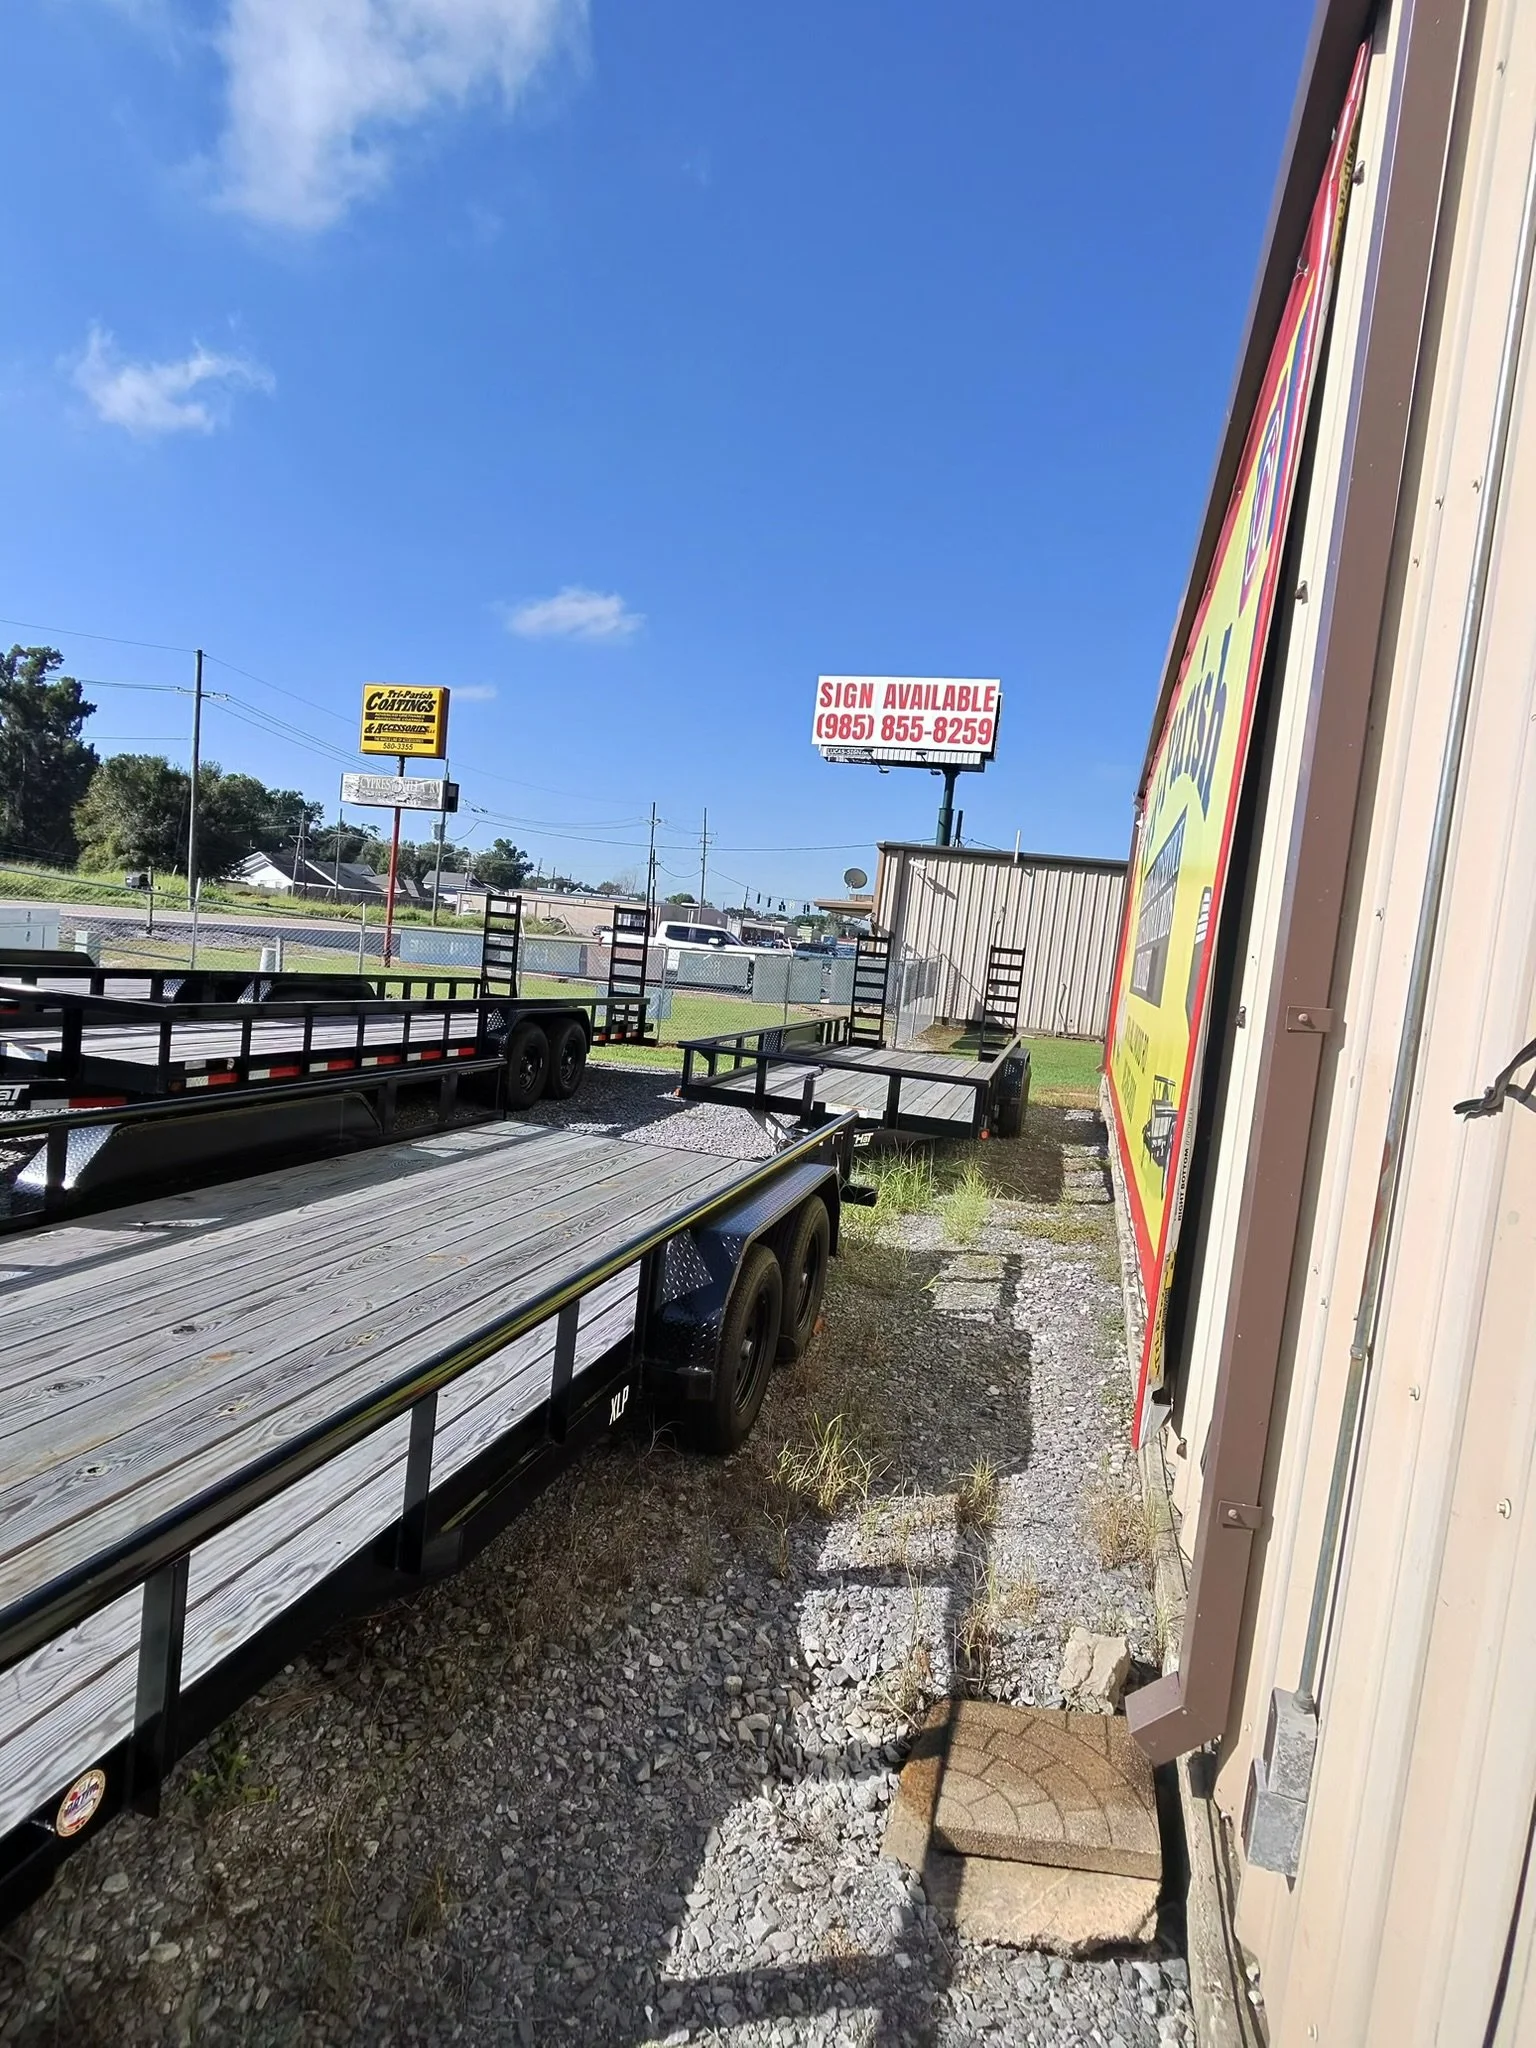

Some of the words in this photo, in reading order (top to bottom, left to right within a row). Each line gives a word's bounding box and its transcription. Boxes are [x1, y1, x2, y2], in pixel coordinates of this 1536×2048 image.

[366, 691, 437, 713] COATINGS
[387, 690, 433, 699] Tri-Parish
[820, 682, 874, 709] SIGN
[883, 683, 996, 713] AVAILABLE
[364, 723, 375, 733] &
[816, 713, 875, 741] (985)
[880, 715, 993, 746] 855-8259
[383, 742, 413, 750] 580-3355
[1179, 1148, 1190, 1190] BOTTOM
[1177, 1190, 1186, 1222] RIGHT
[609, 1385, 630, 1426] XLP
